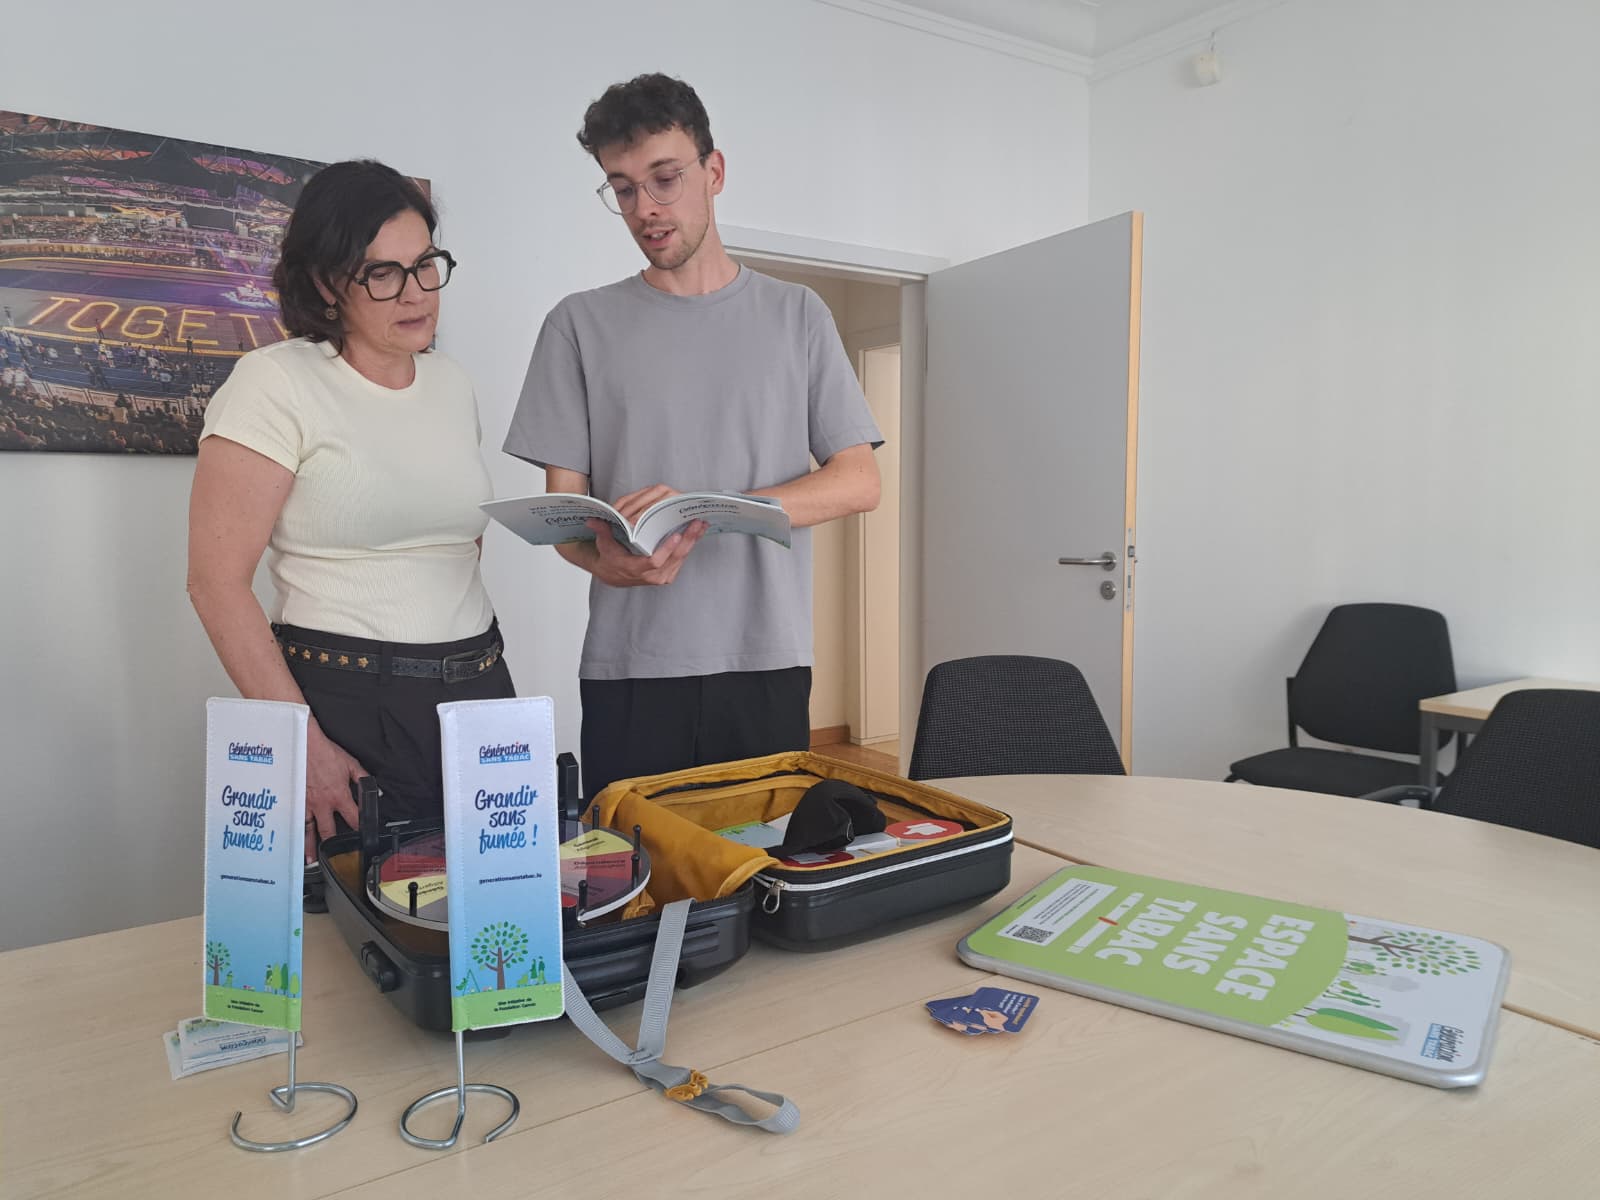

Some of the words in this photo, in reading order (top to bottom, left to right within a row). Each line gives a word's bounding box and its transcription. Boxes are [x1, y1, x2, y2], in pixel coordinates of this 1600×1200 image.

[228, 742, 273, 757] Génération
[479, 742, 530, 758] Génération
[480, 755, 502, 764] SANS
[503, 753, 530, 762] TABAC
[222, 785, 277, 810] Grandir
[475, 785, 538, 810] Grandir
[232, 809, 266, 829] sans
[489, 809, 526, 828] sans
[223, 825, 264, 852] fumée
[268, 830, 275, 852] !
[479, 826, 526, 854] fumée
[532, 824, 538, 846] !
[1095, 897, 1198, 966] TABAC
[1163, 911, 1249, 975] SANS
[1214, 914, 1315, 1001] ESPACE
